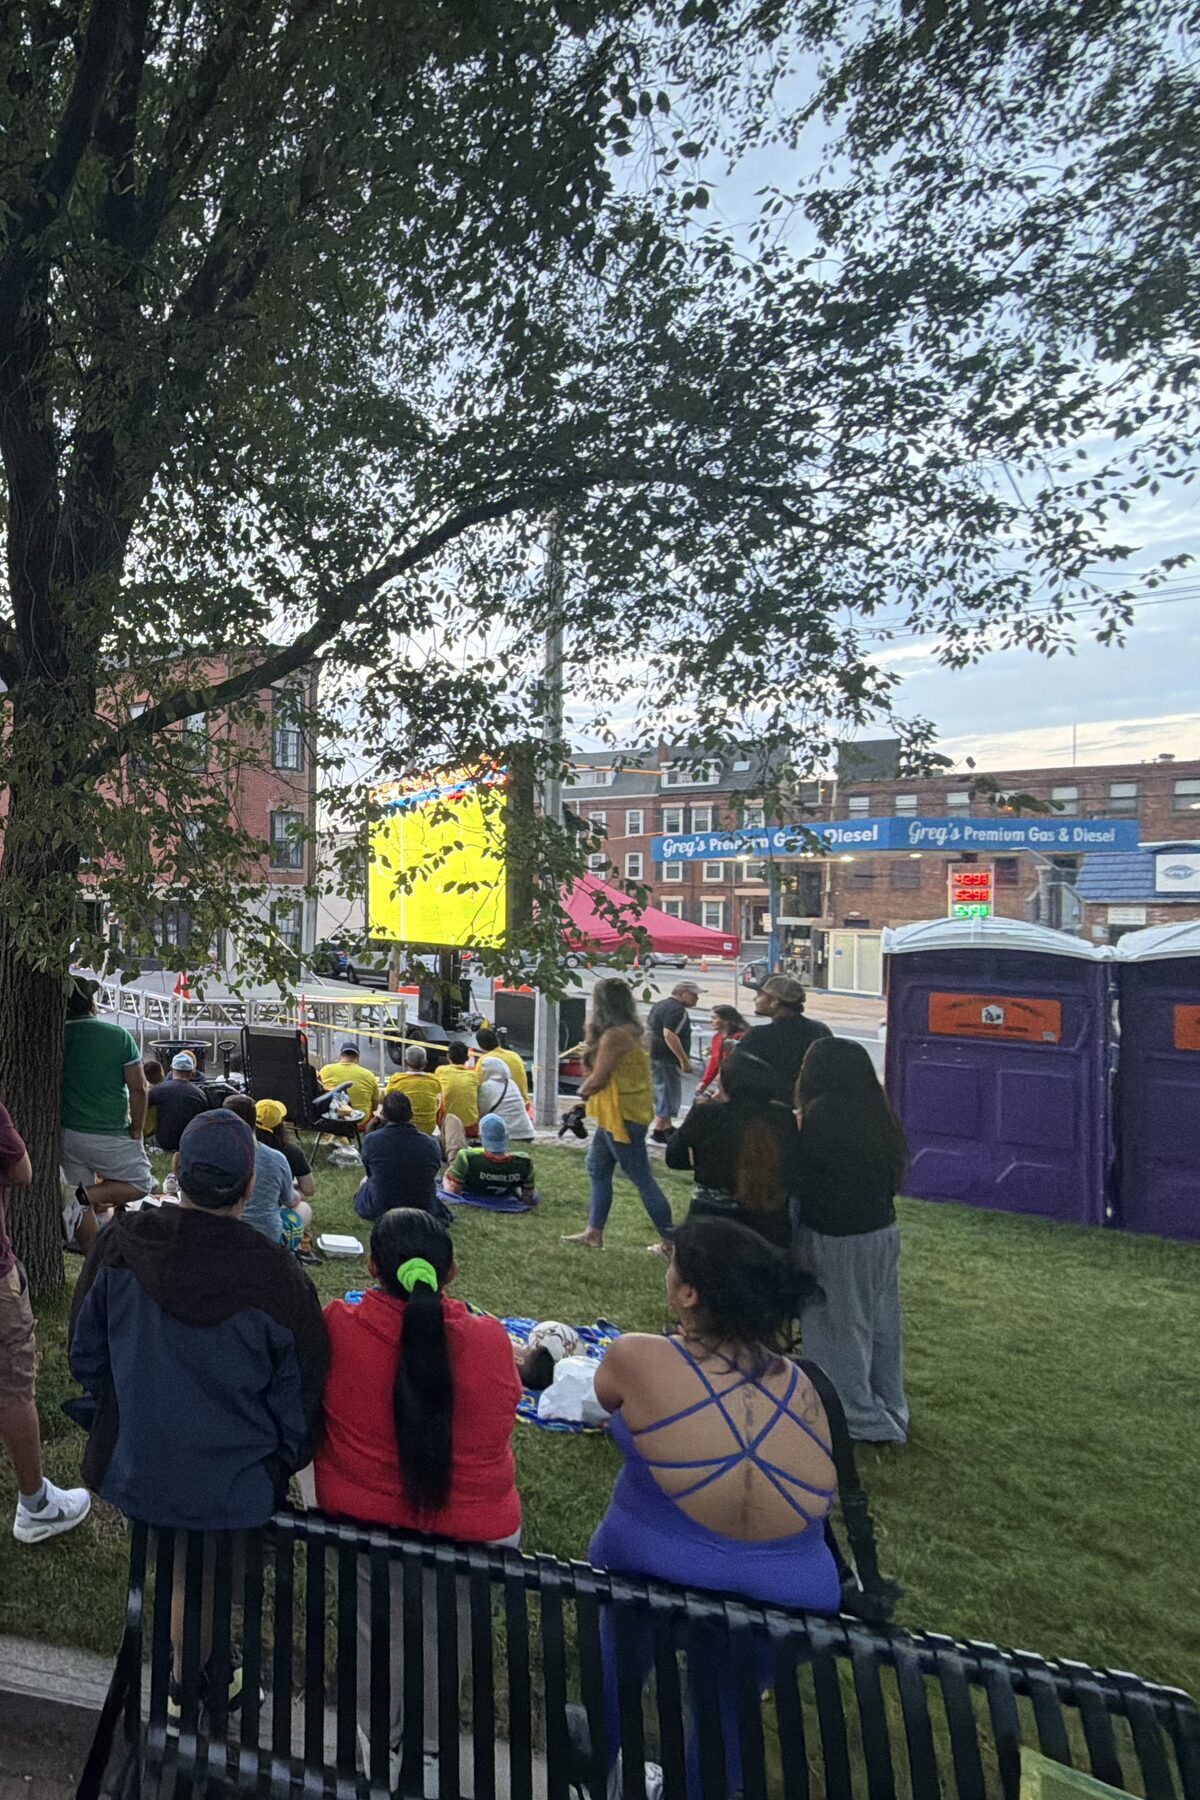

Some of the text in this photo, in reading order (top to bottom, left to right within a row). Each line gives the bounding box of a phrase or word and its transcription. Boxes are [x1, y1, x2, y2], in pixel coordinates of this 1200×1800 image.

[908, 821, 1116, 846] Greg's Premium Gas & Diesel
[663, 836, 706, 858] Greg's
